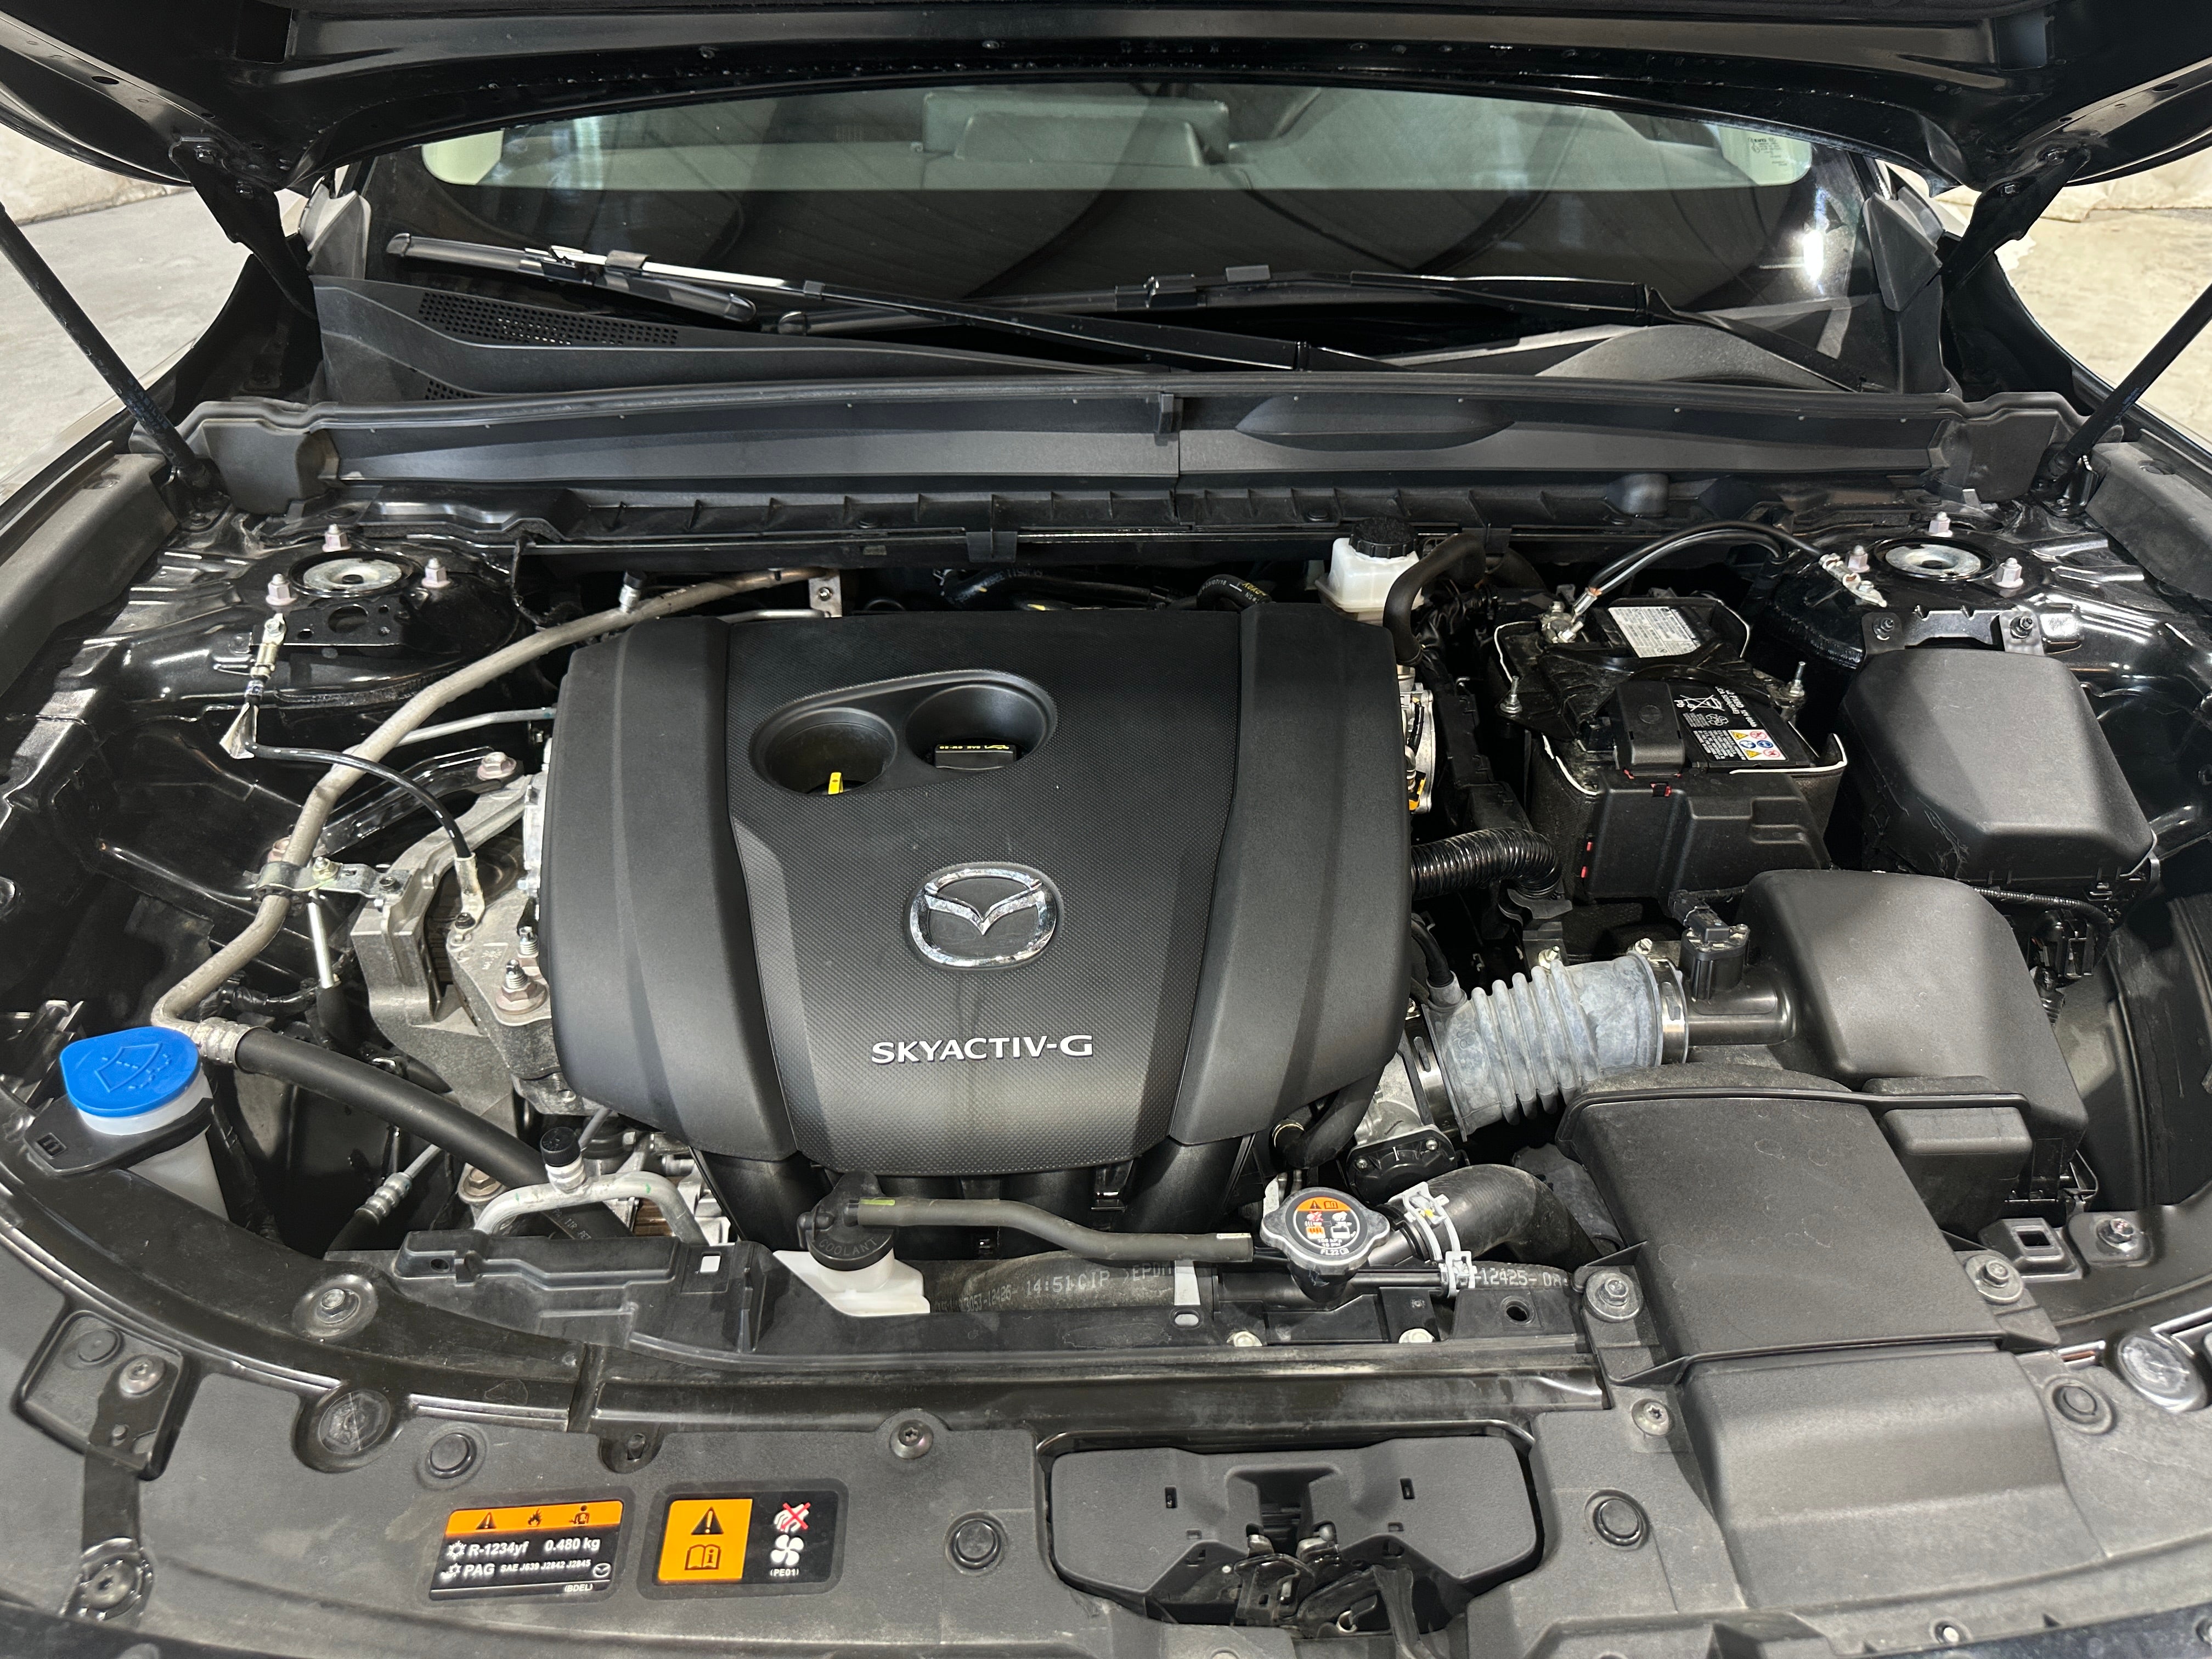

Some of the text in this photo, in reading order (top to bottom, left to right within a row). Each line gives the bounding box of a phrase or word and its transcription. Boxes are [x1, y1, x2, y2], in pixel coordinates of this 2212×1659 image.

[1673, 699, 1685, 708] Pb
[871, 1035, 1093, 1064] SKYACTIV-G
[819, 1237, 877, 1256] COOLANT
[468, 1537, 601, 1556] R-1234yf 0.480 kg
[464, 1563, 495, 1577] PAG
[500, 1564, 519, 1572] SAE
[564, 1583, 593, 1592] (BDEL)
